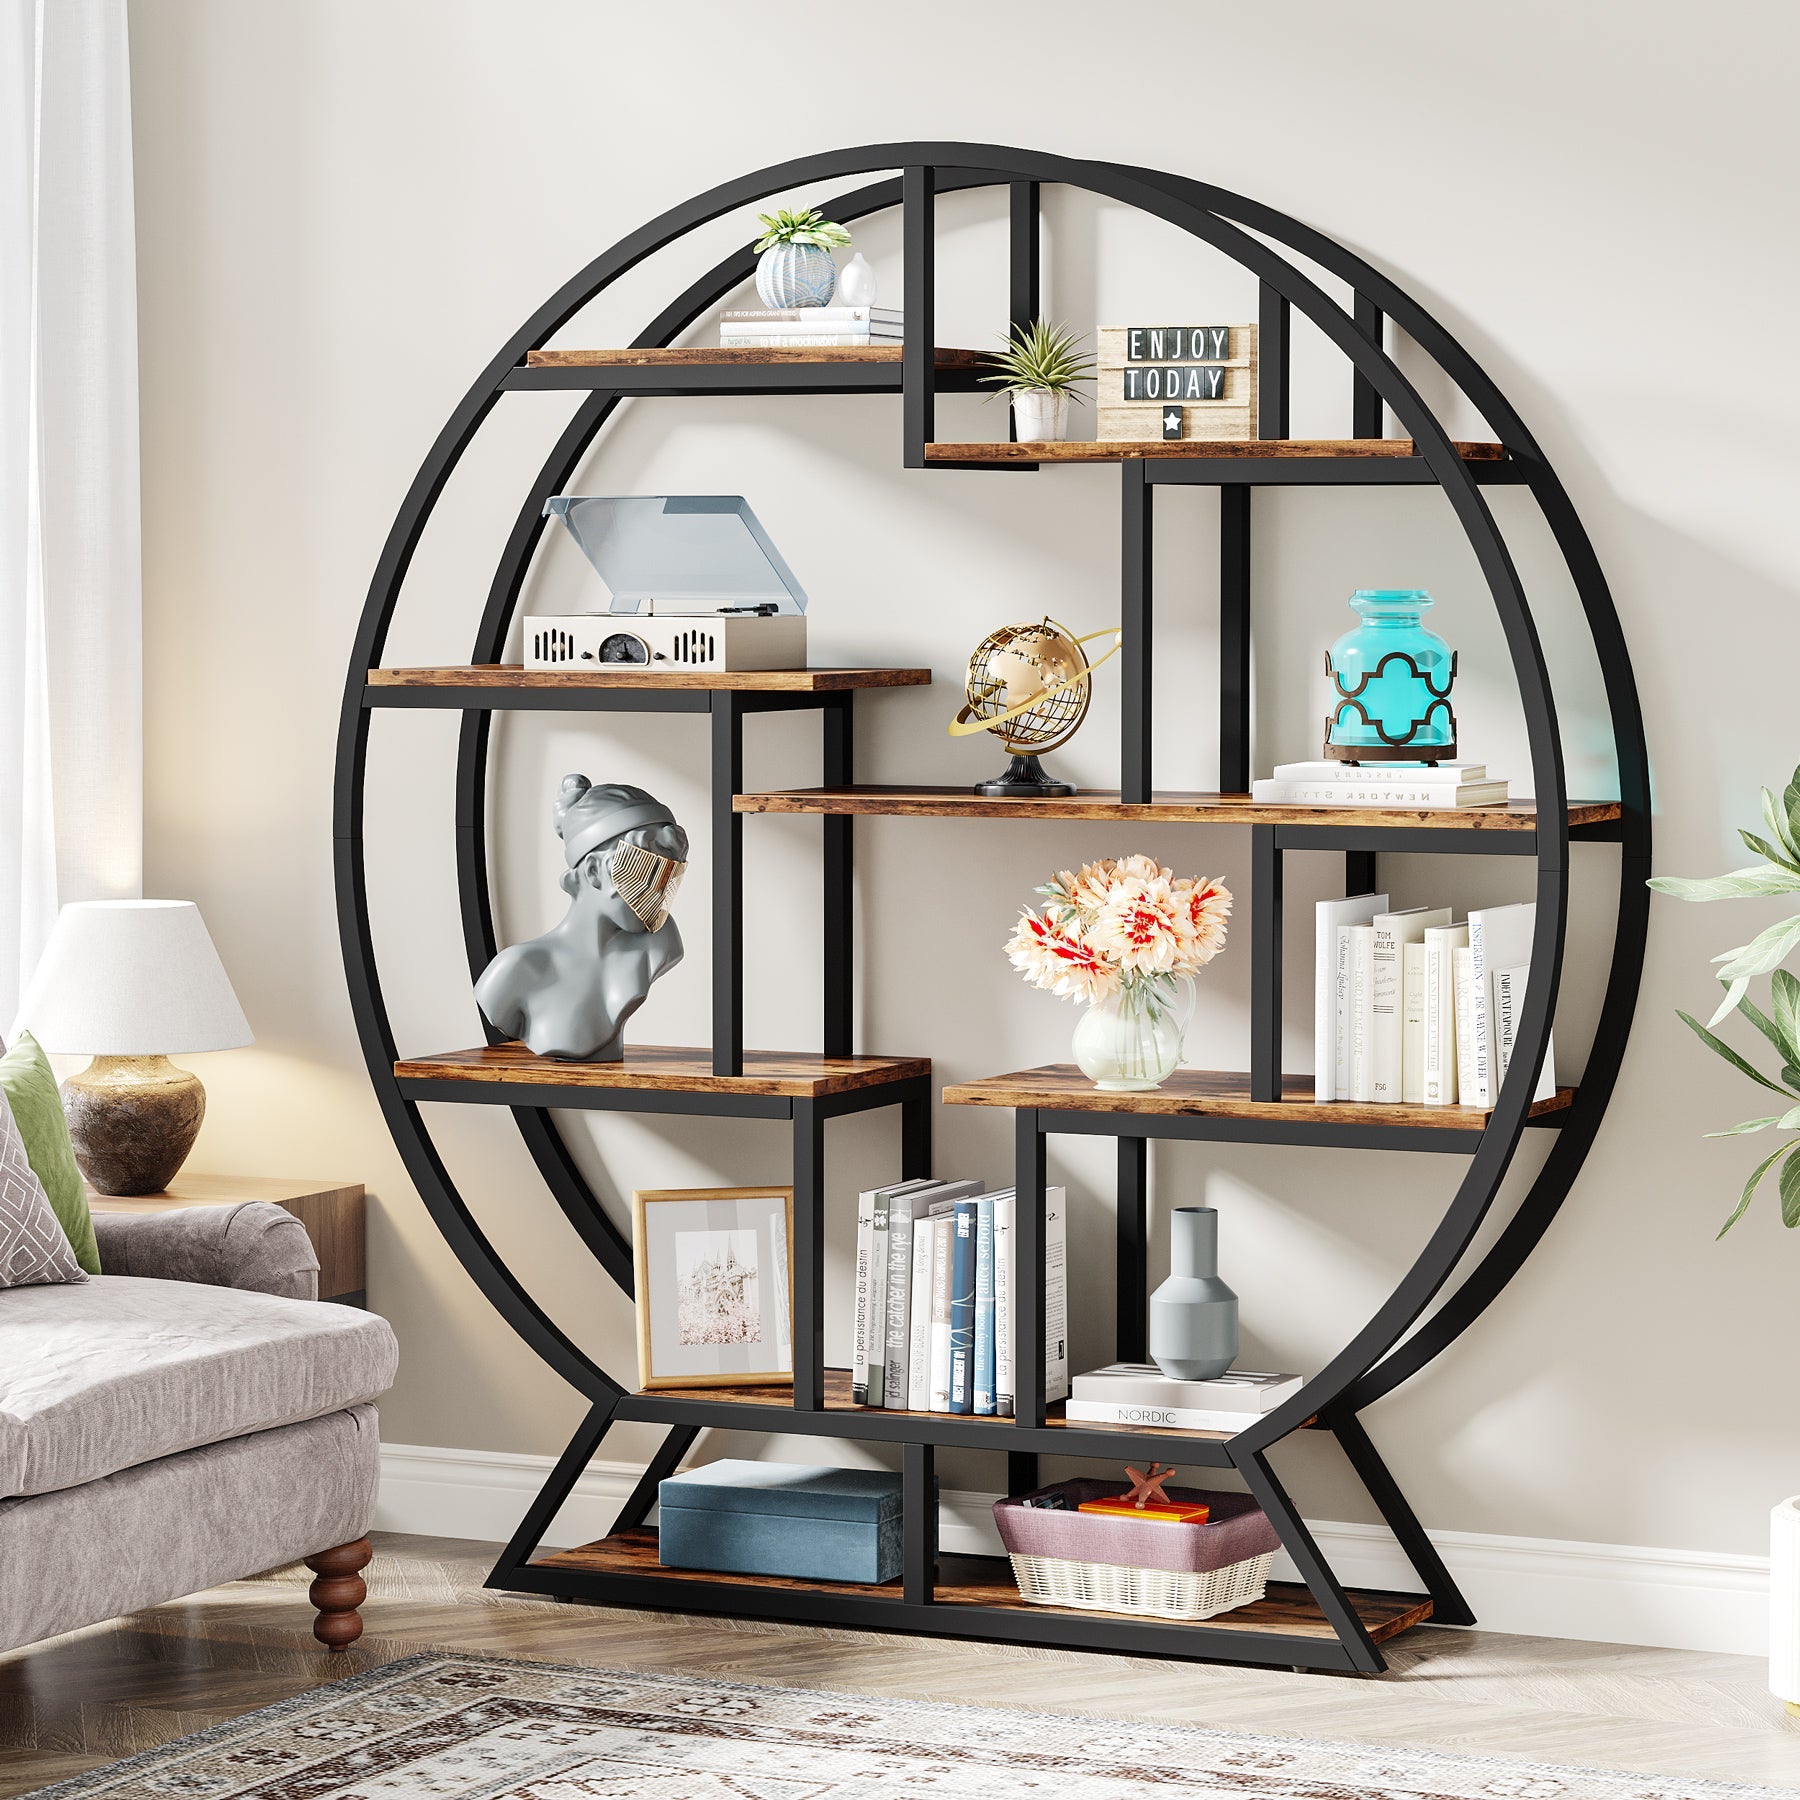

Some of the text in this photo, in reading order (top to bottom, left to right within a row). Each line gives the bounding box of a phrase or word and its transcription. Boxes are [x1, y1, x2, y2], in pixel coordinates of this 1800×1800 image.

[1131, 329, 1225, 359] ENJOY
[1126, 369, 1222, 398] TODAY
[1374, 941, 1395, 950] WOLFE
[1377, 931, 1391, 940] TOM
[1339, 936, 1351, 971] Johanna
[1430, 952, 1438, 976] MAN
[1472, 924, 1483, 980] INSPIRATION
[1336, 972, 1349, 1000] Lindsey
[1430, 980, 1438, 1002] AND
[1501, 974, 1512, 1010] INDECENT
[1430, 1005, 1438, 1026] THE
[1456, 976, 1470, 1028] ARCTIC
[1476, 1013, 1486, 1042] WAYNE
[1503, 1011, 1513, 1047] EXPOSURE
[1429, 1030, 1438, 1071] FUTURE
[1458, 1034, 1472, 1091] DREAMS
[1477, 1056, 1487, 1078] DYER
[1375, 1083, 1387, 1091] FSG
[977, 1214, 991, 1259] sebold
[976, 1263, 990, 1294] alice
[856, 1249, 870, 1366] La persistance du destin
[886, 1232, 911, 1399] jd salinger the catcher in the rye
[995, 1258, 1011, 1376] La persistance du destin
[976, 1333, 988, 1356] lovely
[976, 1357, 985, 1371] the
[1118, 1409, 1176, 1423] NORDIC
